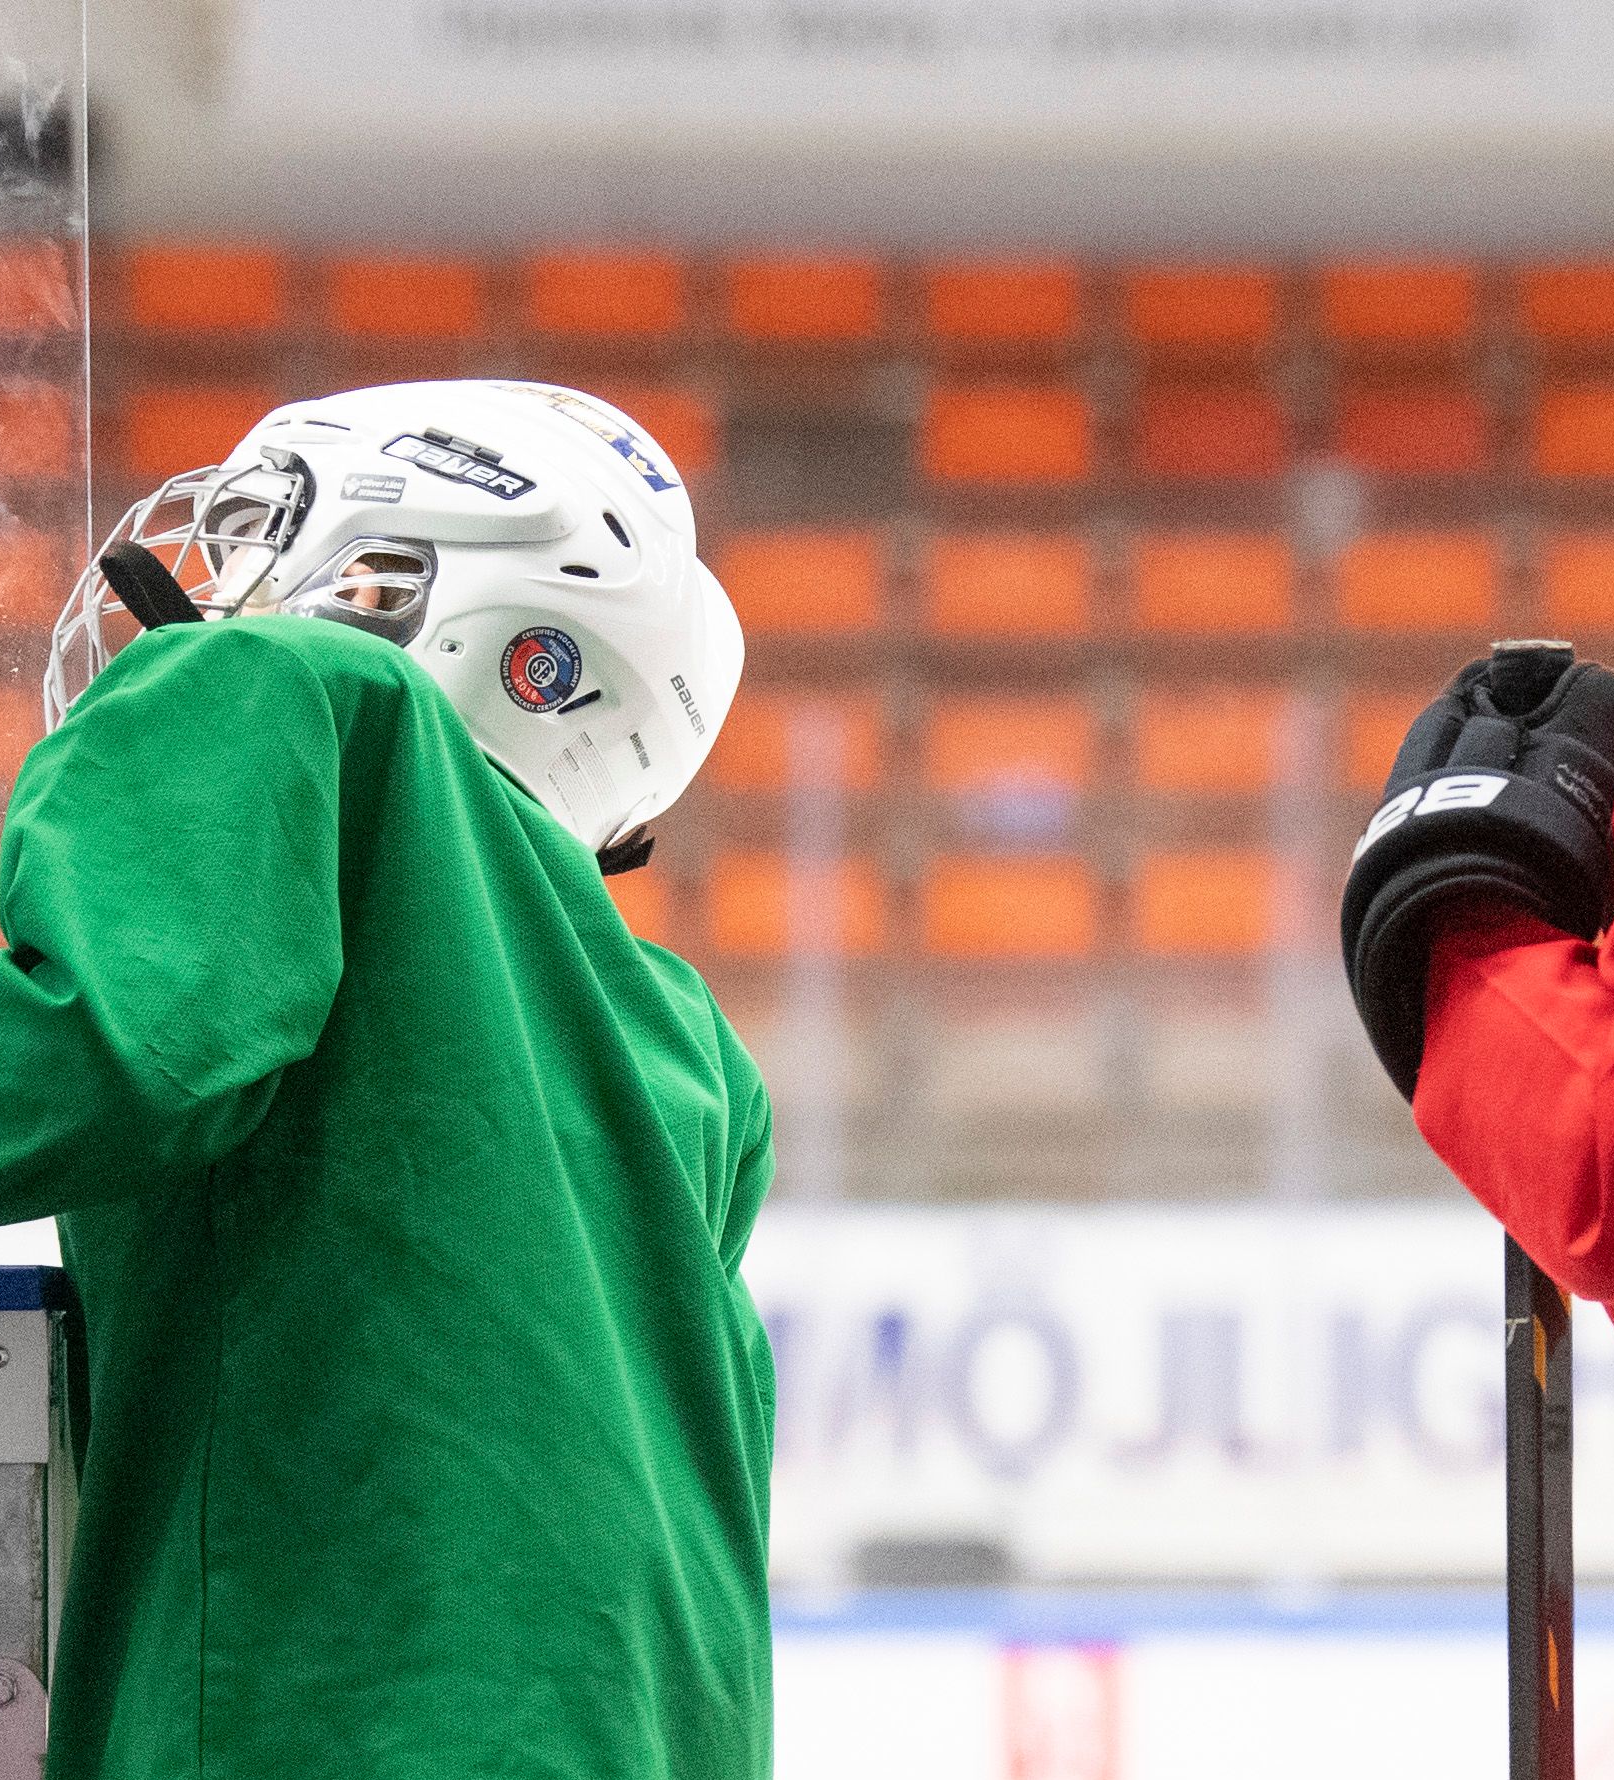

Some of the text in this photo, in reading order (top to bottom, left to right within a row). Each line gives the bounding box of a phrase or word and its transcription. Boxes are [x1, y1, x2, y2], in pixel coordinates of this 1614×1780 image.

[502, 645, 515, 677] CASQUE
[509, 690, 536, 710] HOCKEY
[521, 628, 556, 640] CERTIFIED
[556, 633, 579, 658] HOCKEY
[570, 659, 581, 688] HELMET
[670, 674, 706, 738] BAUER
